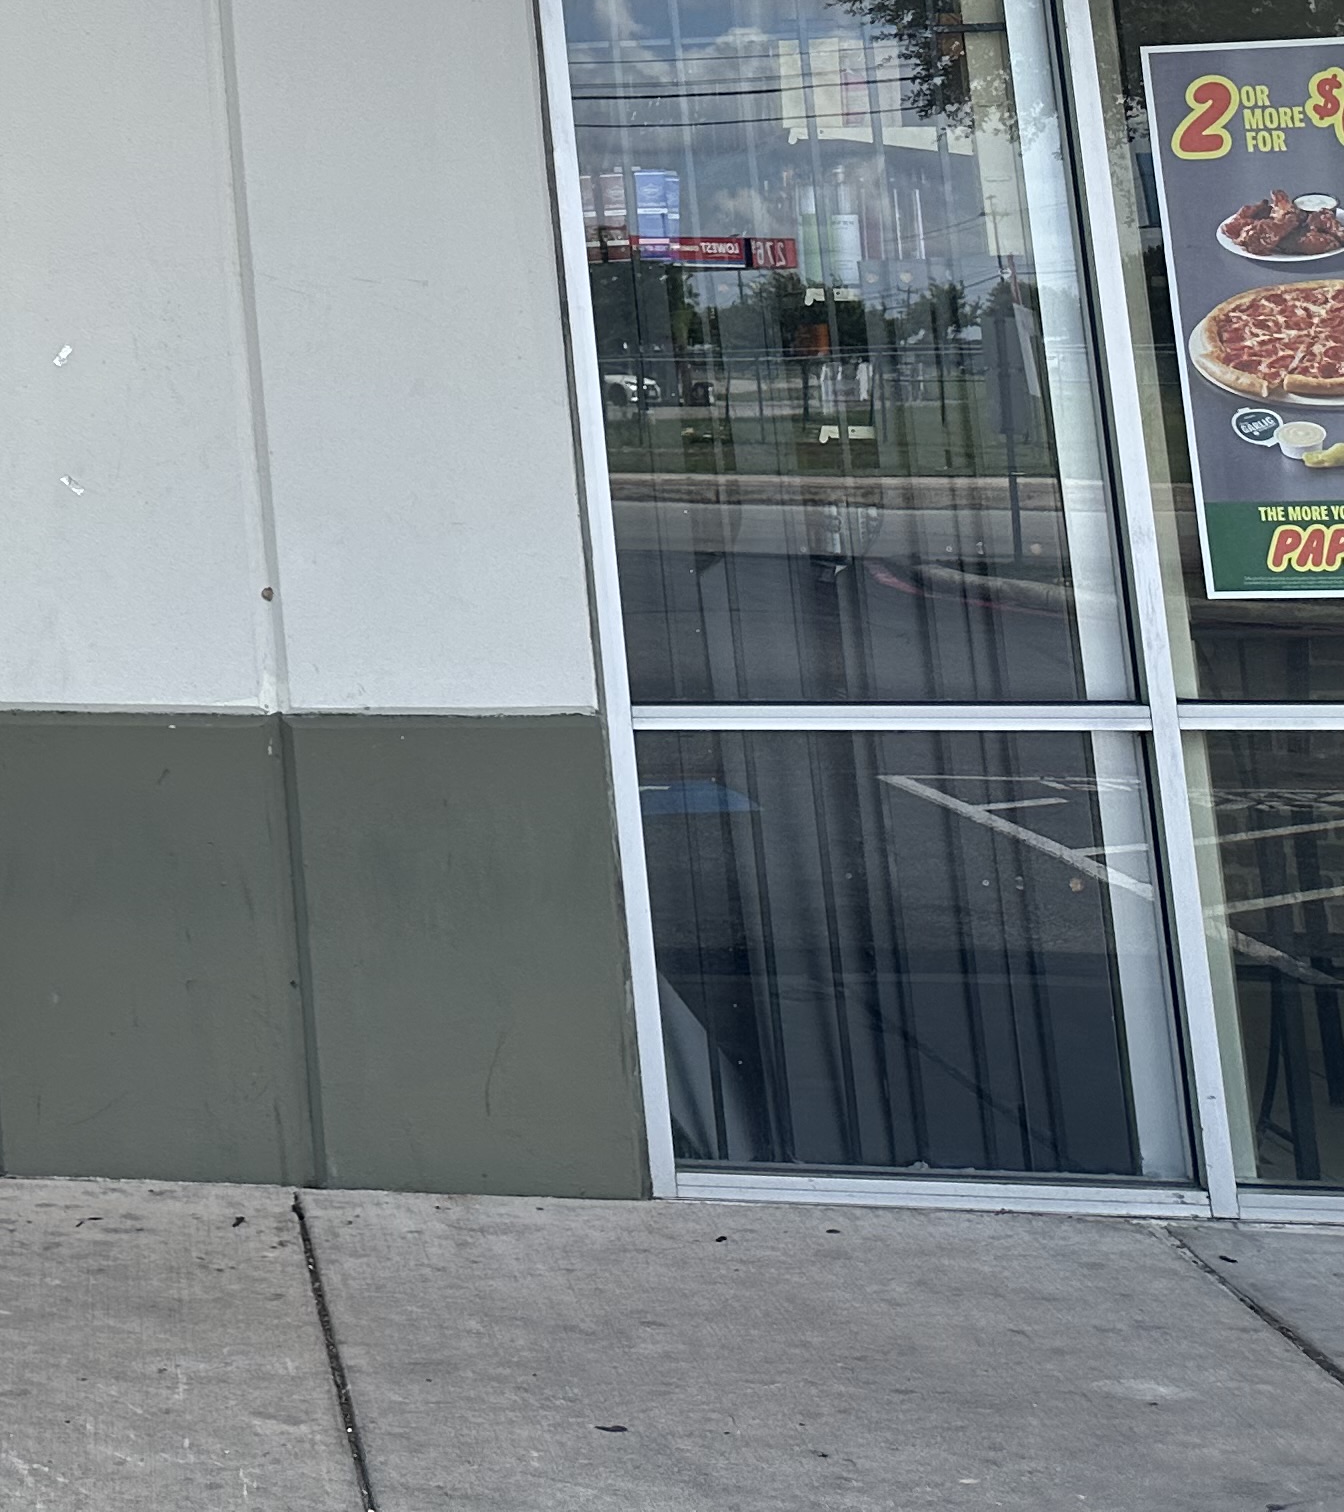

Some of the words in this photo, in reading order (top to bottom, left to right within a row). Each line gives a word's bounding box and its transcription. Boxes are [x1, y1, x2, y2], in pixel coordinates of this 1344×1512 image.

[1240, 85, 1270, 106] OR
[1174, 76, 1237, 158] 2
[1243, 107, 1305, 129] MORE
[1246, 131, 1287, 152] FOR
[1258, 506, 1286, 521] THE
[1288, 506, 1329, 521] MORE
[1269, 525, 1344, 571] PAP
